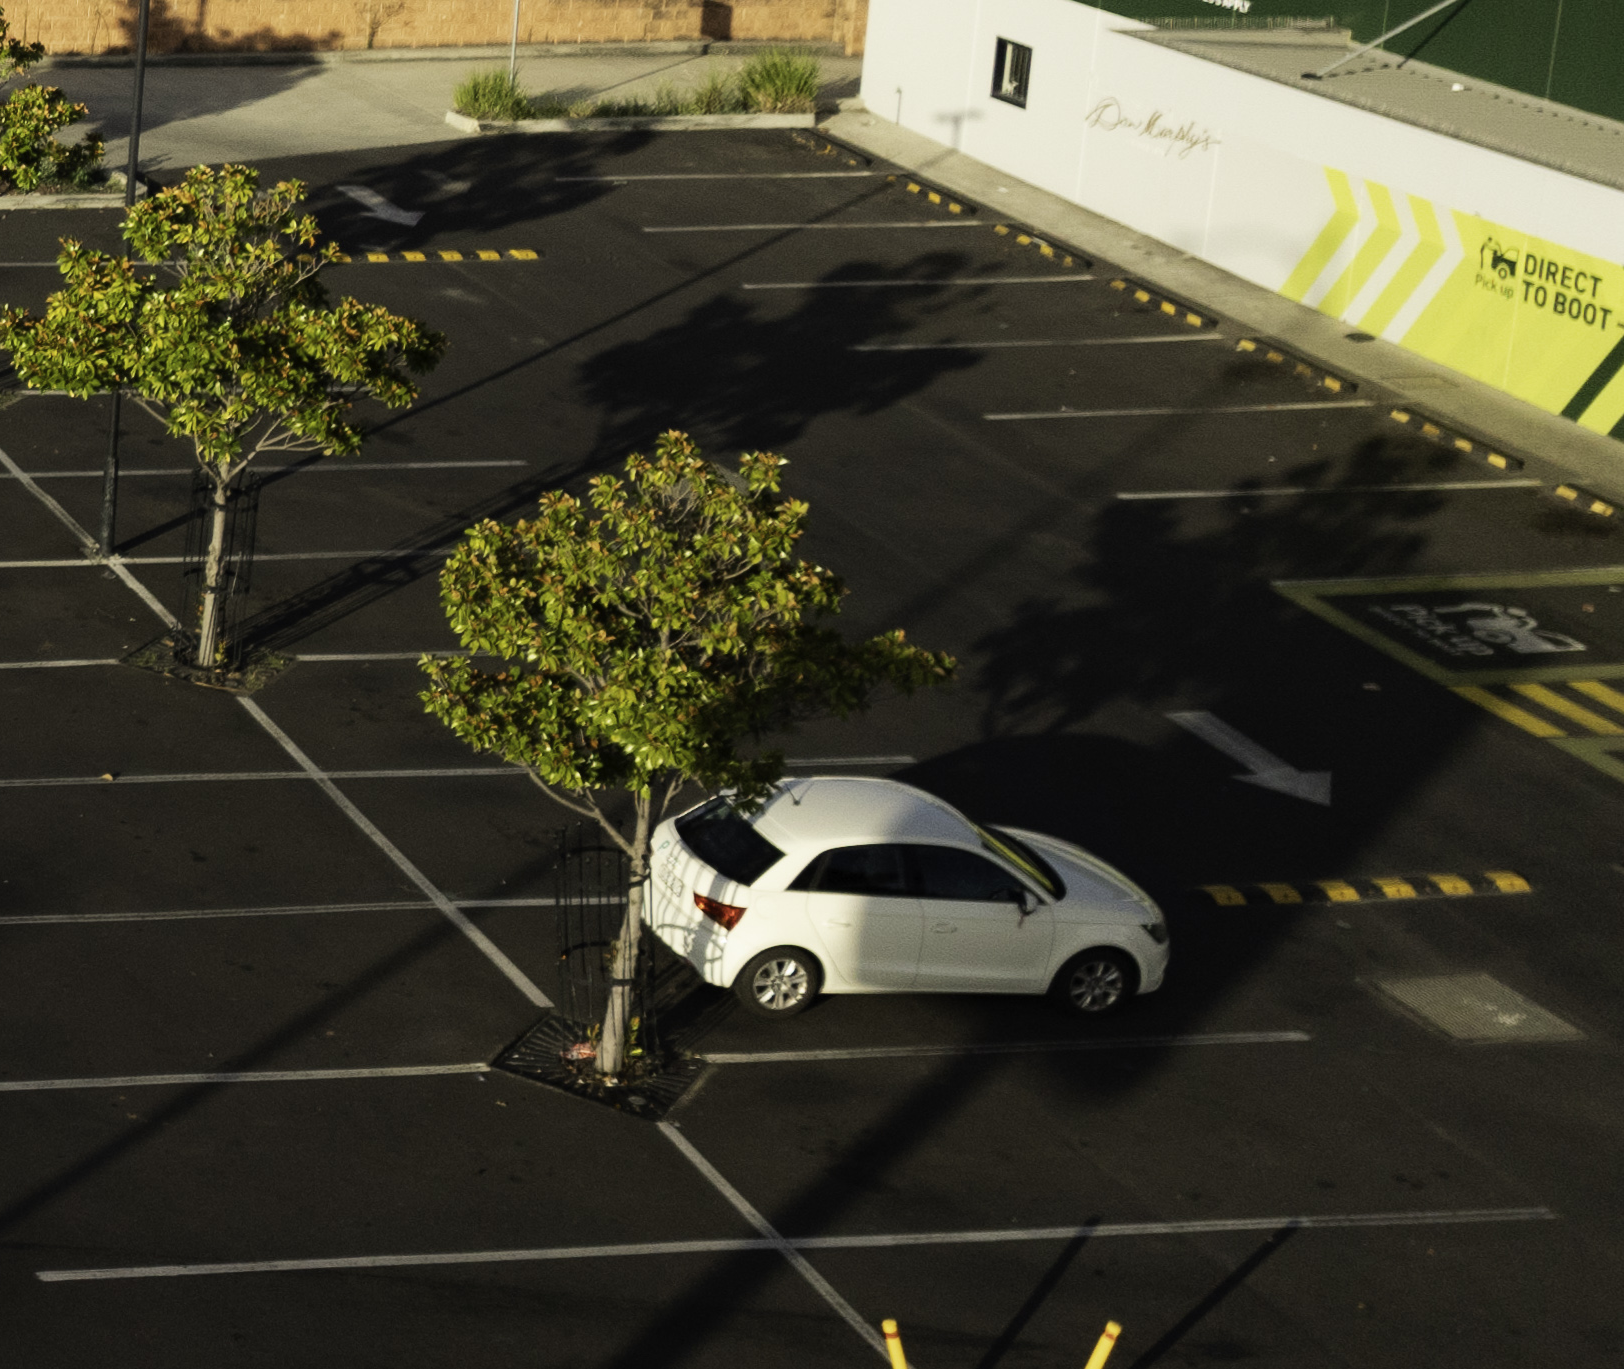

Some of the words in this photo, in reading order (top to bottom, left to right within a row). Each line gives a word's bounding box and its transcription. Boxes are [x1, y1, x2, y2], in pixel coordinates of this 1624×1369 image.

[1474, 272, 1498, 294] Pick
[1499, 284, 1515, 301] up
[1523, 252, 1604, 299] DIRECT
[1521, 279, 1550, 308] TO
[1552, 293, 1614, 331] BOOT
